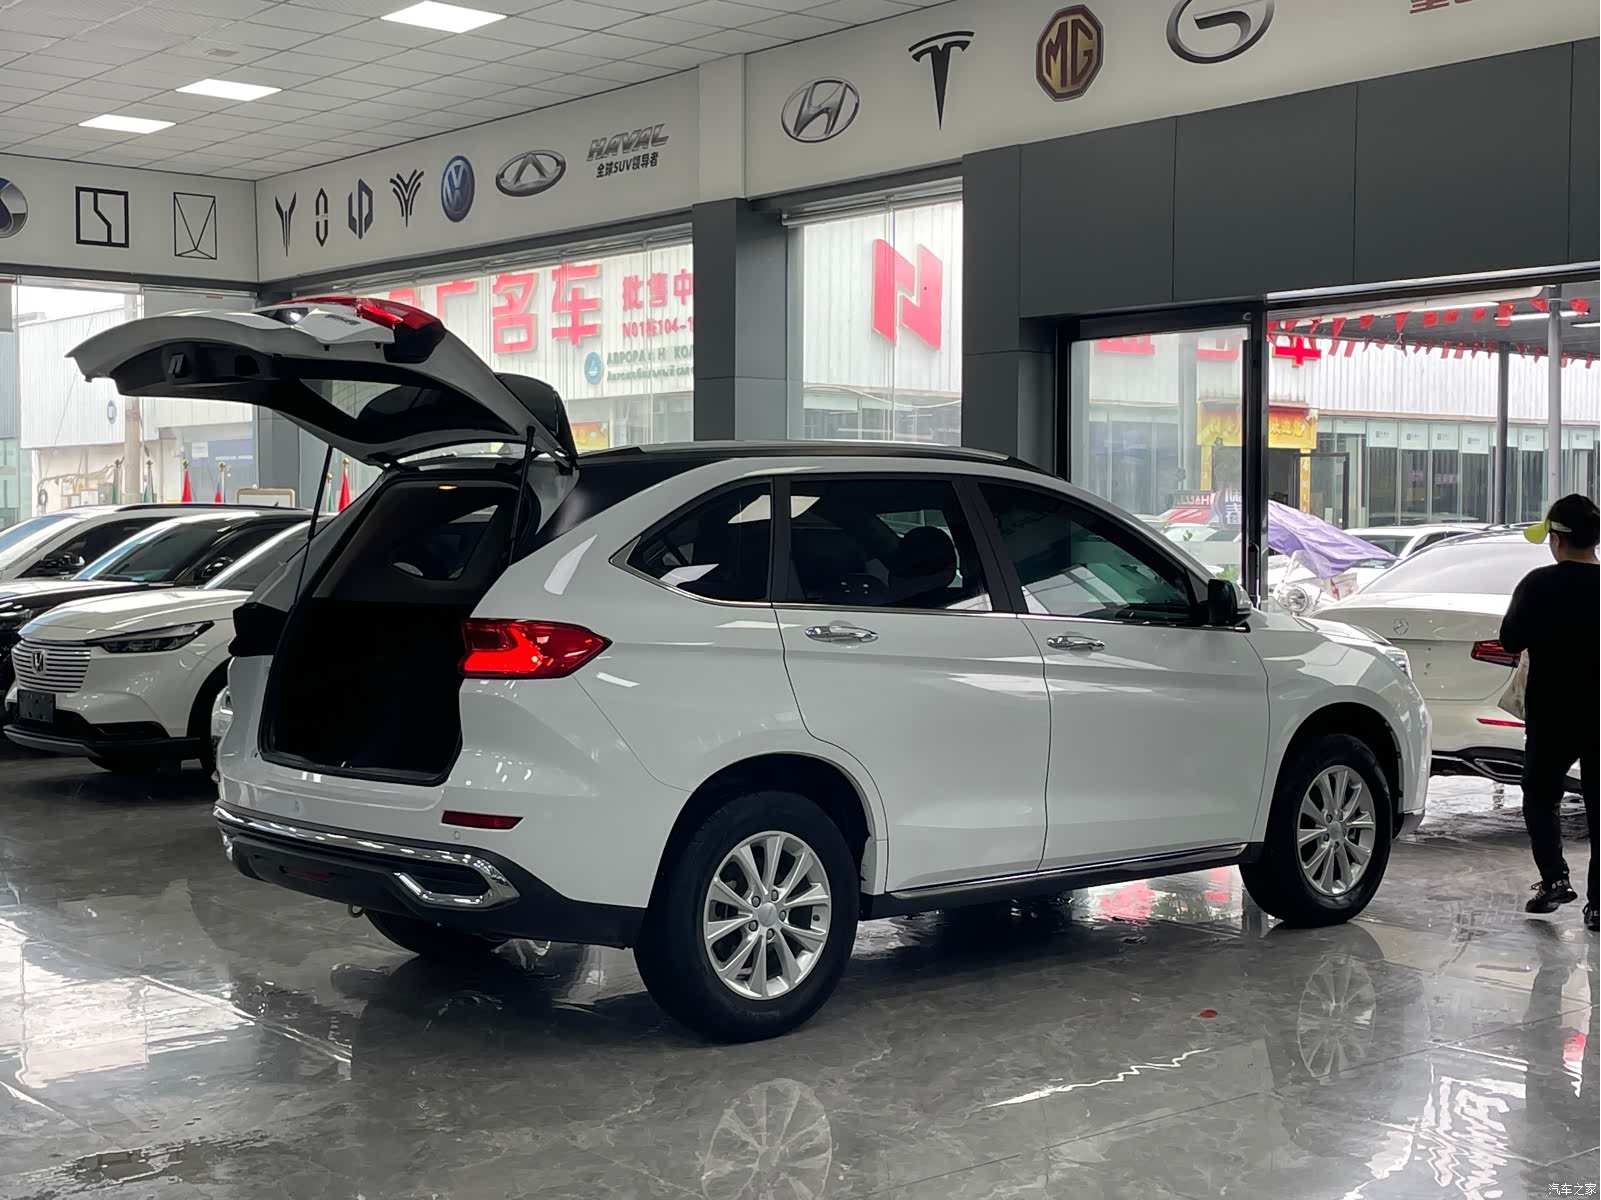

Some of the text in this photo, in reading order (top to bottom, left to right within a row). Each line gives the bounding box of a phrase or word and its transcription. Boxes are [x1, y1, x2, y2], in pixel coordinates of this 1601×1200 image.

[1044, 16, 1096, 90] MG
[586, 123, 669, 162] HAVAL
[596, 151, 659, 178] 全球SUV领导者
